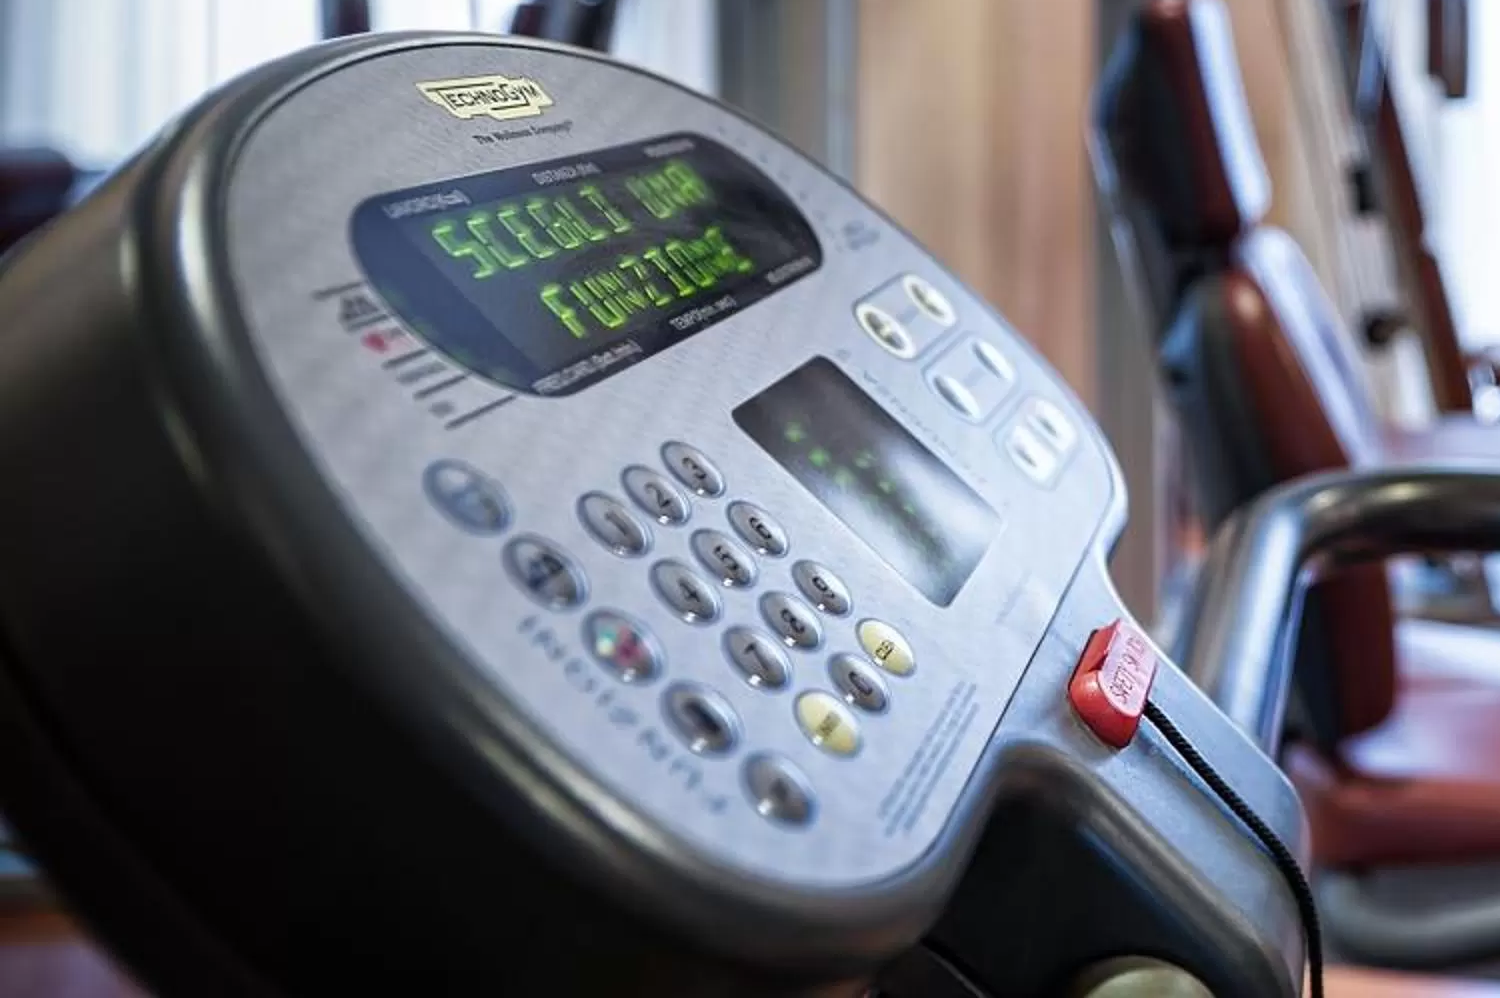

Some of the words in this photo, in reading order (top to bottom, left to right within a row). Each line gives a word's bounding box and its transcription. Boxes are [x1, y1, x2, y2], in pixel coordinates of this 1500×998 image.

[431, 185, 632, 279] SCEGLI
[625, 162, 708, 219] UNA
[540, 226, 753, 339] FUNZIONE
[682, 456, 707, 480] 3
[643, 482, 671, 508] 2
[603, 510, 632, 537] 1
[749, 516, 773, 540] 6
[713, 545, 740, 571] 5
[678, 579, 702, 607] 4
[811, 576, 836, 599] 9
[780, 608, 806, 634] 8
[745, 642, 770, 671] 7
[848, 671, 874, 697] 0
